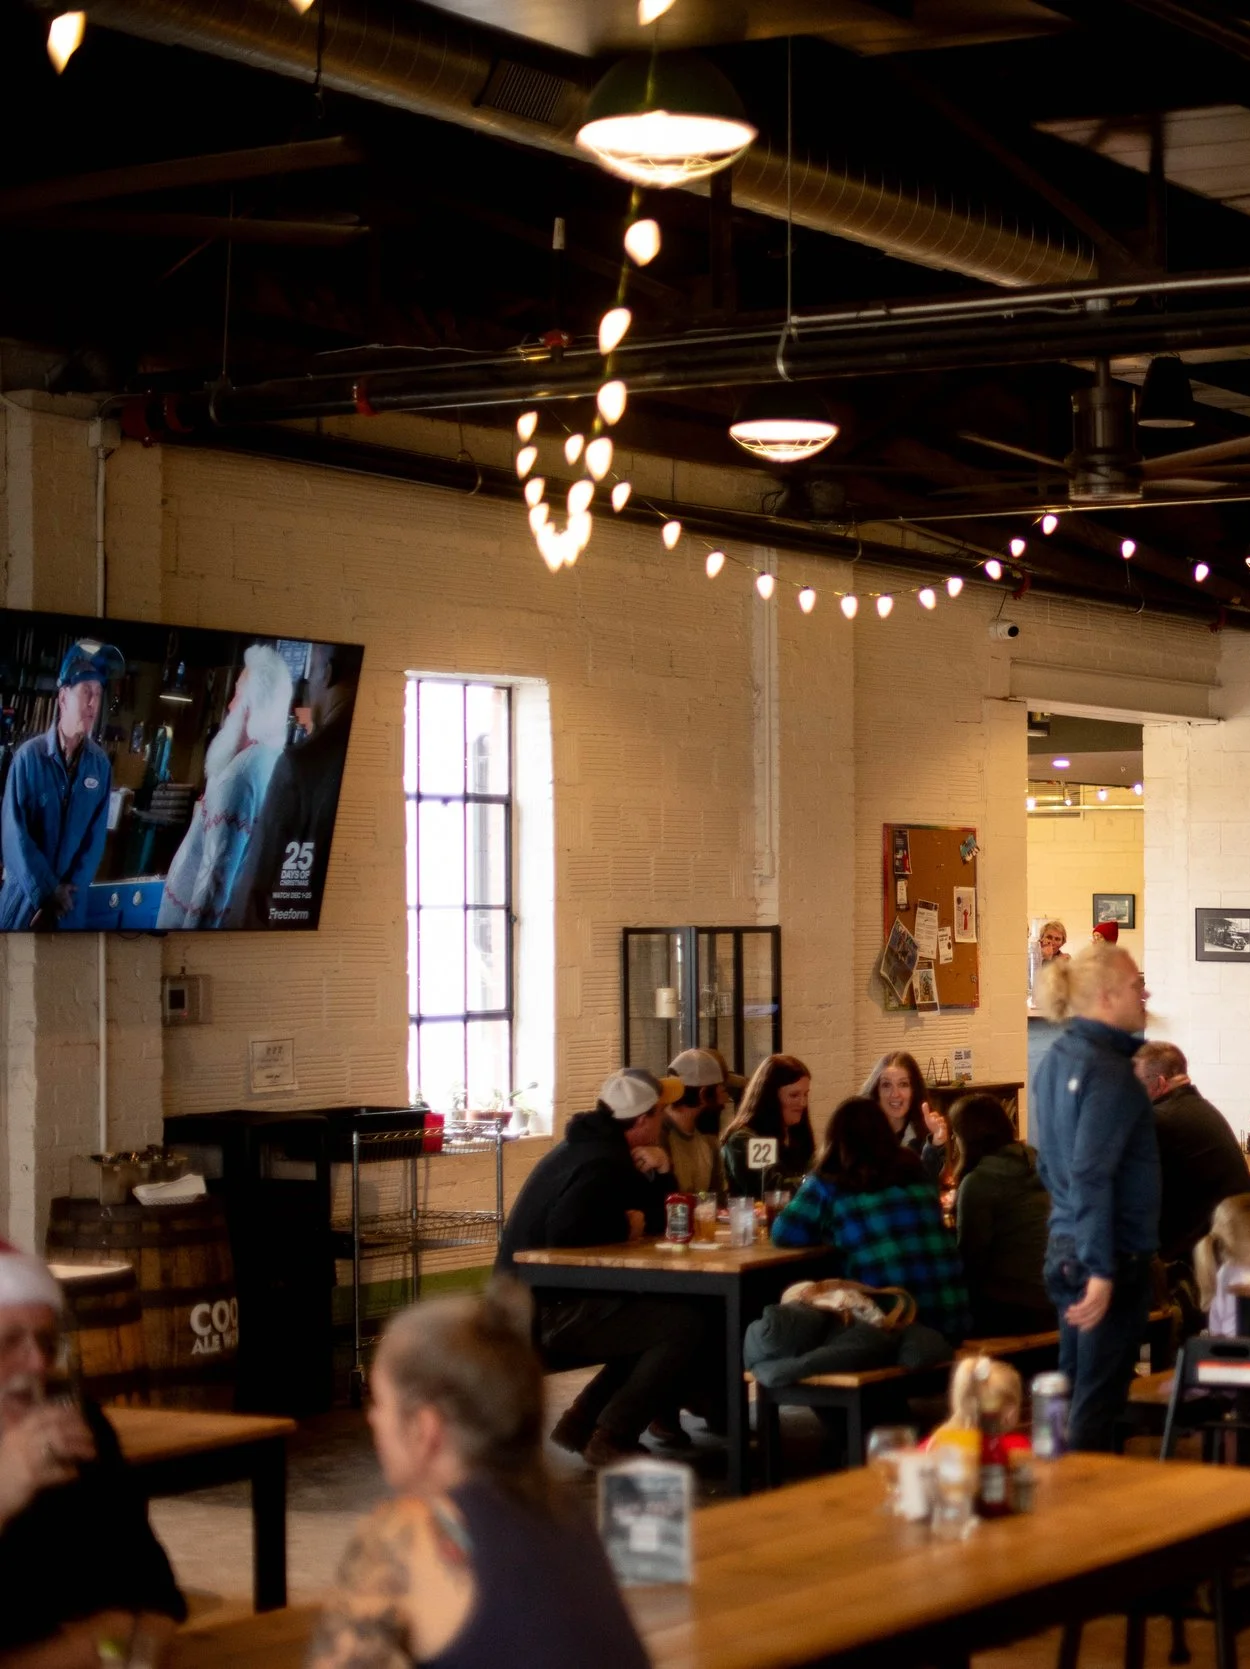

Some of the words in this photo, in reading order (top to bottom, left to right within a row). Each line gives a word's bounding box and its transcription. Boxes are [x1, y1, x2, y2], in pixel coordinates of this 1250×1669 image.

[282, 841, 315, 870] 25
[281, 870, 299, 879] DAYS
[300, 870, 310, 879] OF
[268, 907, 309, 920] Freeform
[753, 1143, 771, 1163] 22
[191, 1334, 220, 1355] ALE
